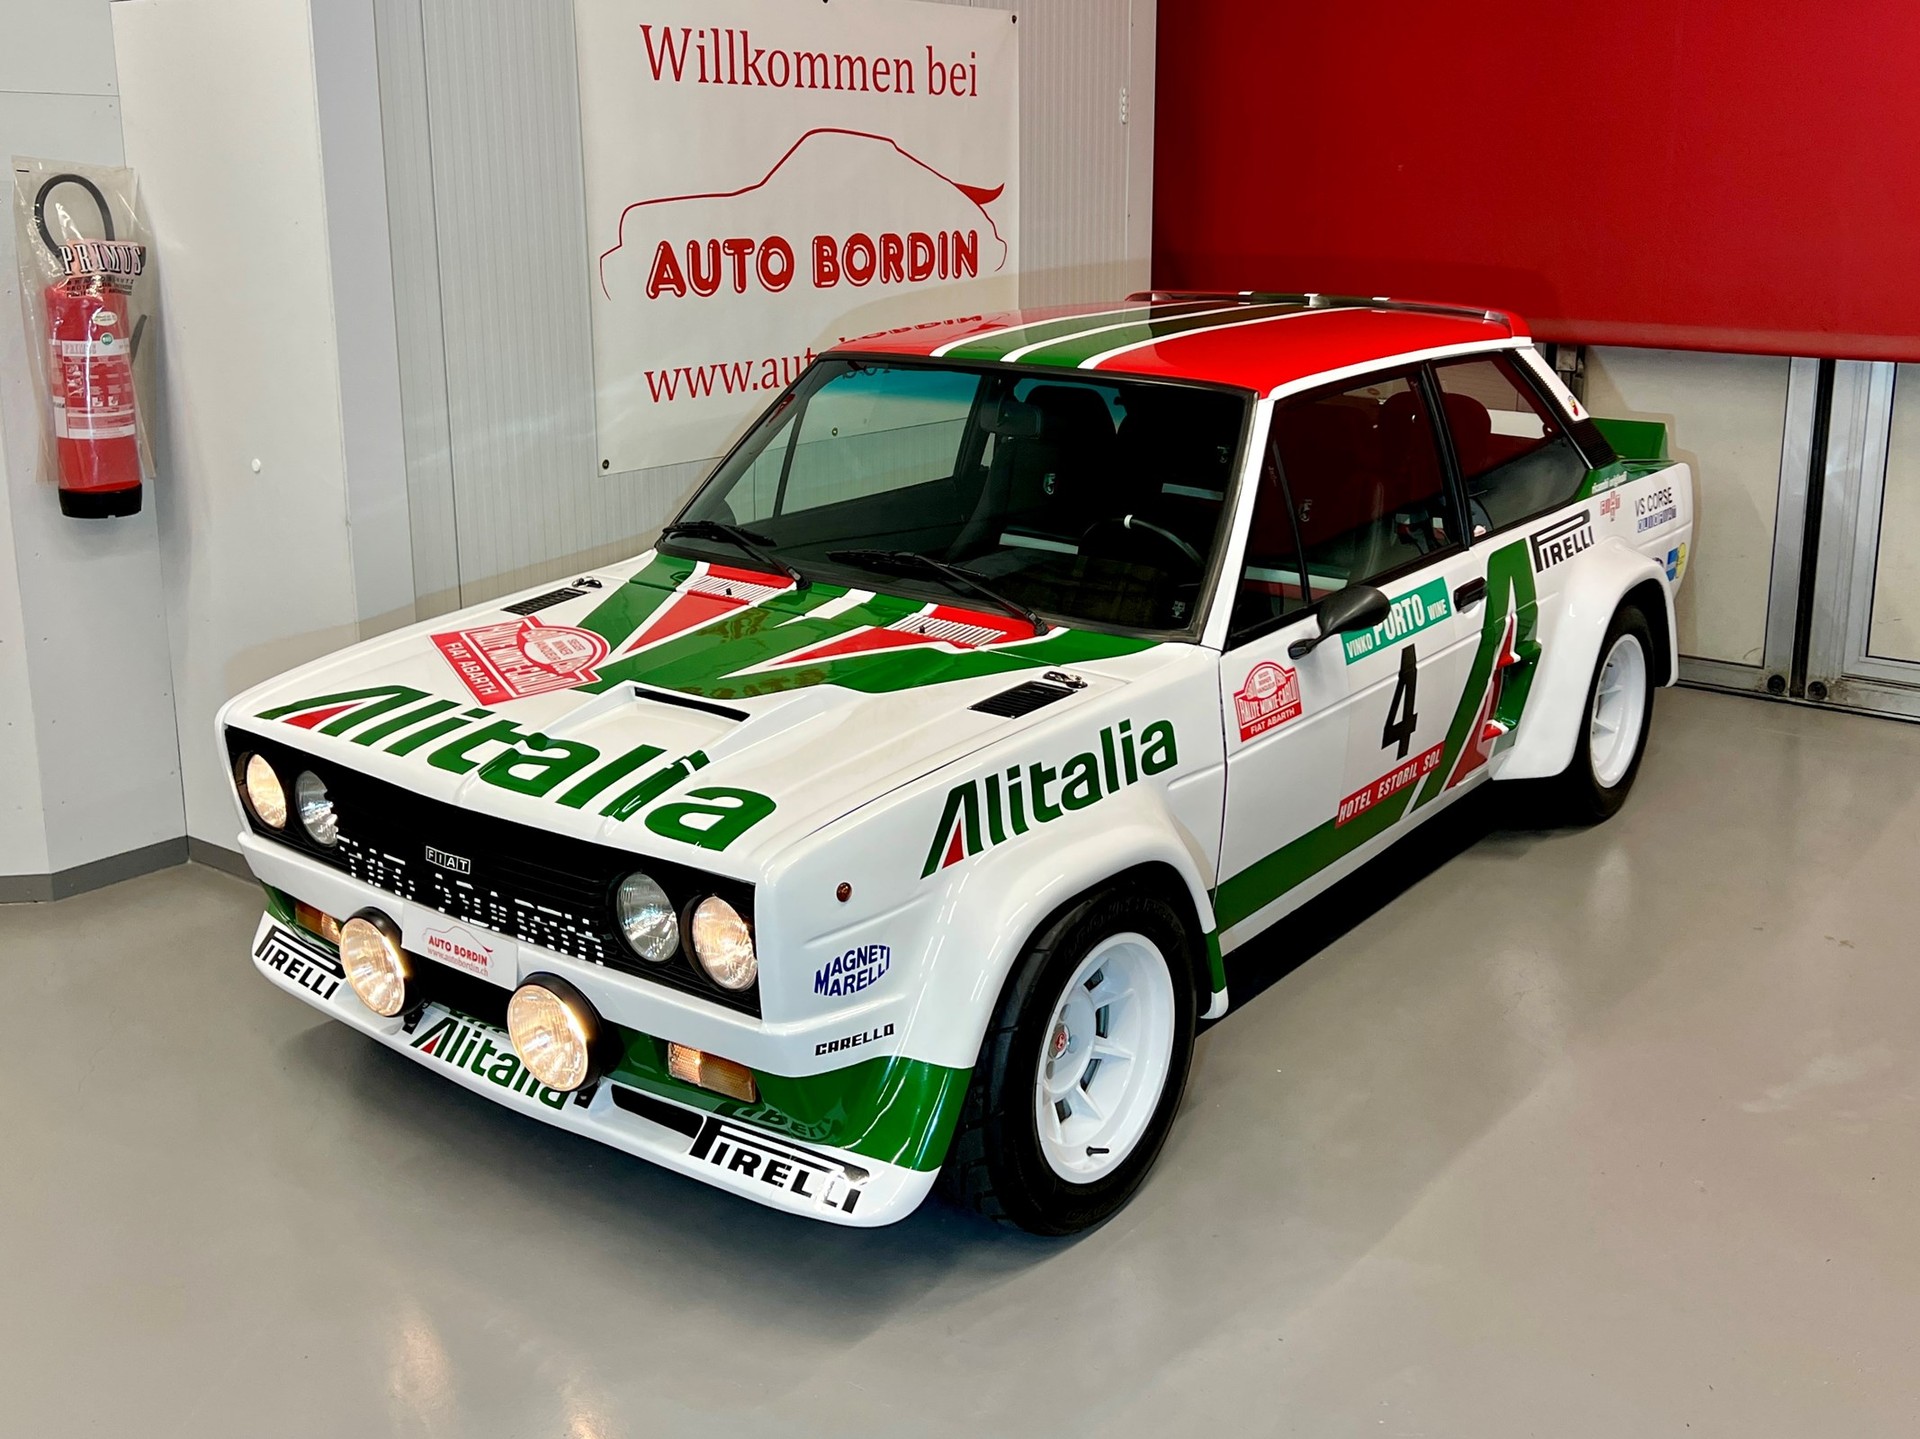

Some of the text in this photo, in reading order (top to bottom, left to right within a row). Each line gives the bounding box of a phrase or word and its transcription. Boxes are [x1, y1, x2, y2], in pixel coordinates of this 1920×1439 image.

[640, 24, 978, 97] Willkommen bei
[59, 243, 142, 276] PRIMUS
[646, 230, 978, 300] AUTO BORDIN
[1635, 498, 1646, 517] VS
[1648, 487, 1673, 512] CORSE
[1529, 509, 1595, 574] PIRELLI
[1427, 599, 1447, 620] WINE
[444, 641, 500, 697] FIAT ABARTH
[1250, 706, 1296, 735] FIAT ABARTH
[1381, 643, 1418, 761] 4
[253, 684, 777, 853] Alitalia
[1338, 748, 1441, 823] HOTEL ESTORIL SOL
[920, 718, 1179, 880] Alitalia
[426, 847, 471, 874] FIAT
[254, 925, 348, 1000] PIRELLI
[427, 946, 489, 977] www.autobordin.ch
[428, 935, 488, 967] AUTO BORDIN
[814, 945, 890, 988] MAGNETI
[814, 962, 890, 996] MARELLI
[815, 1023, 895, 1057] CARELLO
[688, 1115, 870, 1214] PIRELLI
